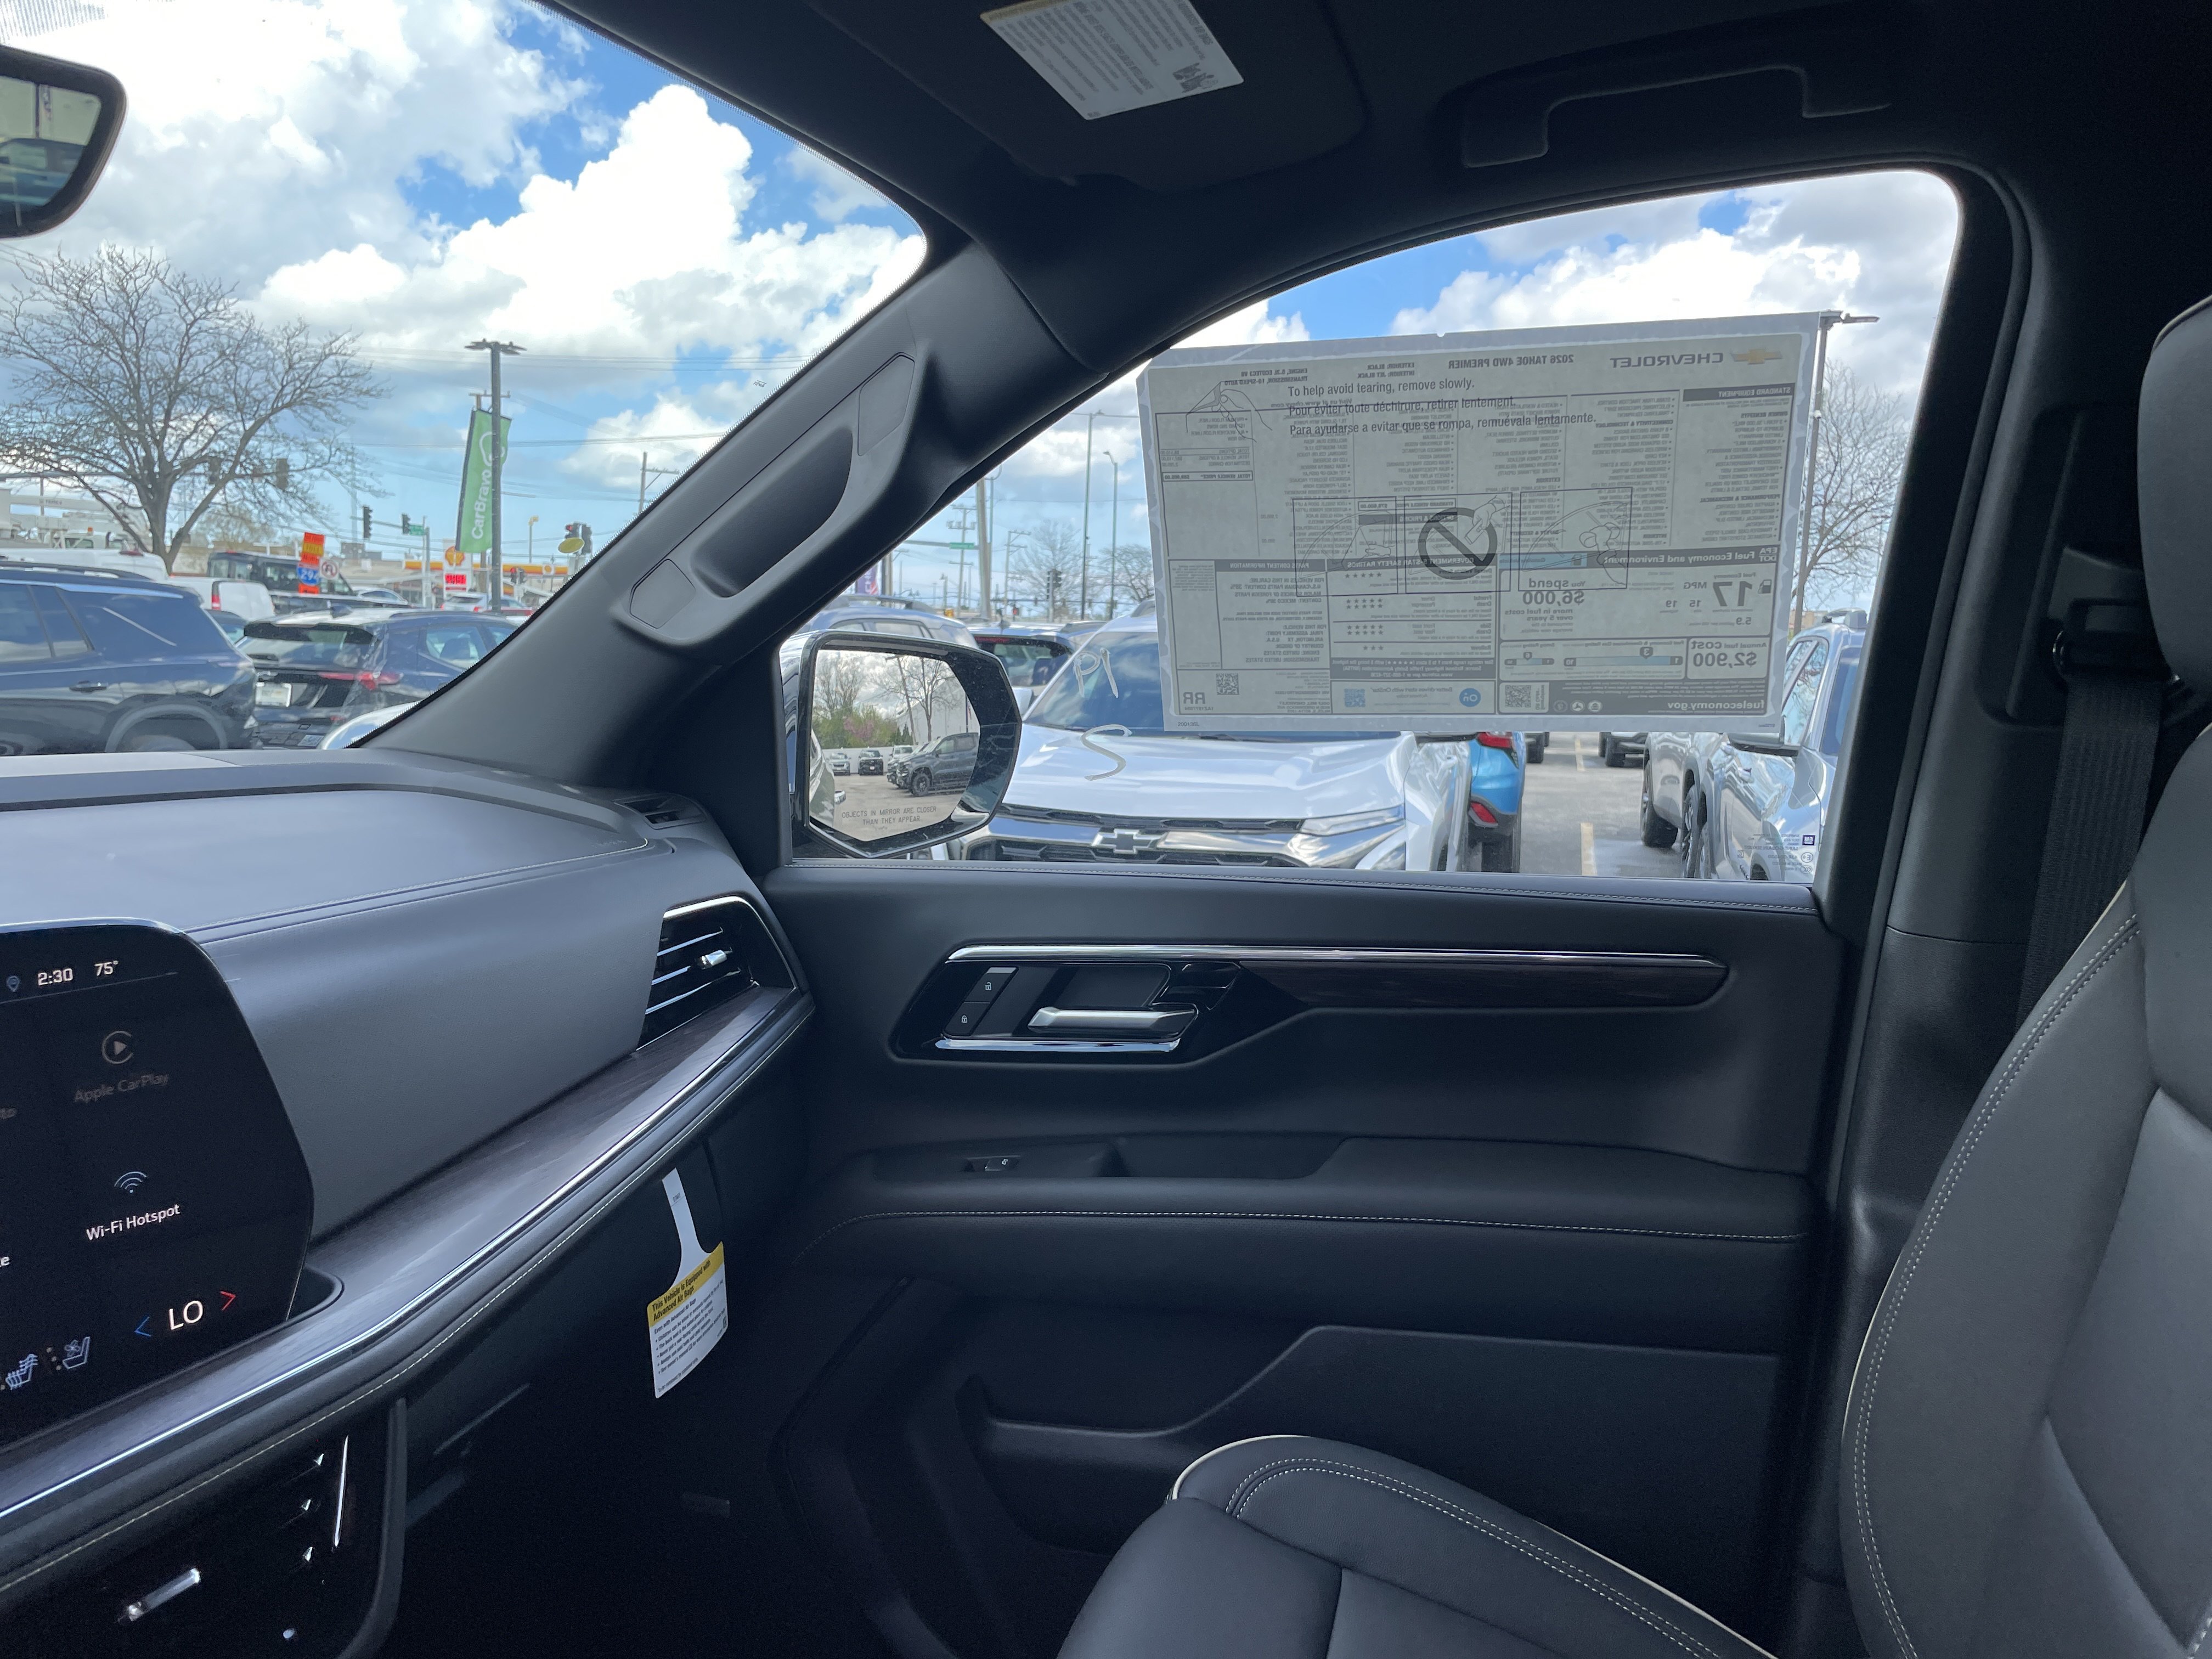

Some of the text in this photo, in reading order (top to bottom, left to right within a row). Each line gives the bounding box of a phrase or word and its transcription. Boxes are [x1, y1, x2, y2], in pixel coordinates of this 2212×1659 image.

[1288, 377, 1475, 398] To help avoid tearing, remove slowly.
[1289, 405, 1311, 416] Pour
[1314, 403, 1341, 414] éviter
[1344, 402, 1370, 413] toute
[1427, 399, 1458, 409] retirer
[1462, 396, 1516, 409] lentement.
[1290, 425, 1311, 435] Para
[1314, 424, 1359, 437] ayudarse
[1372, 422, 1398, 432] evitar
[1402, 422, 1420, 433] que
[1438, 419, 1474, 431] rompa,
[1477, 415, 1531, 428] remuévala
[1535, 413, 1596, 425] lentamente.
[472, 470, 492, 539] CarBravo
[842, 810, 867, 819] OBJECTS
[37, 960, 118, 986] 2:30 75°
[74, 1073, 170, 1104] Apple CarPlay
[86, 1204, 181, 1240] Wi-Fi Hotspot
[652, 1301, 663, 1312] This
[664, 1286, 680, 1304] Vehicle
[686, 1266, 703, 1287] Equipped
[653, 1299, 676, 1321] Advanced
[684, 1285, 695, 1298] Bags
[168, 1300, 204, 1331] LO
